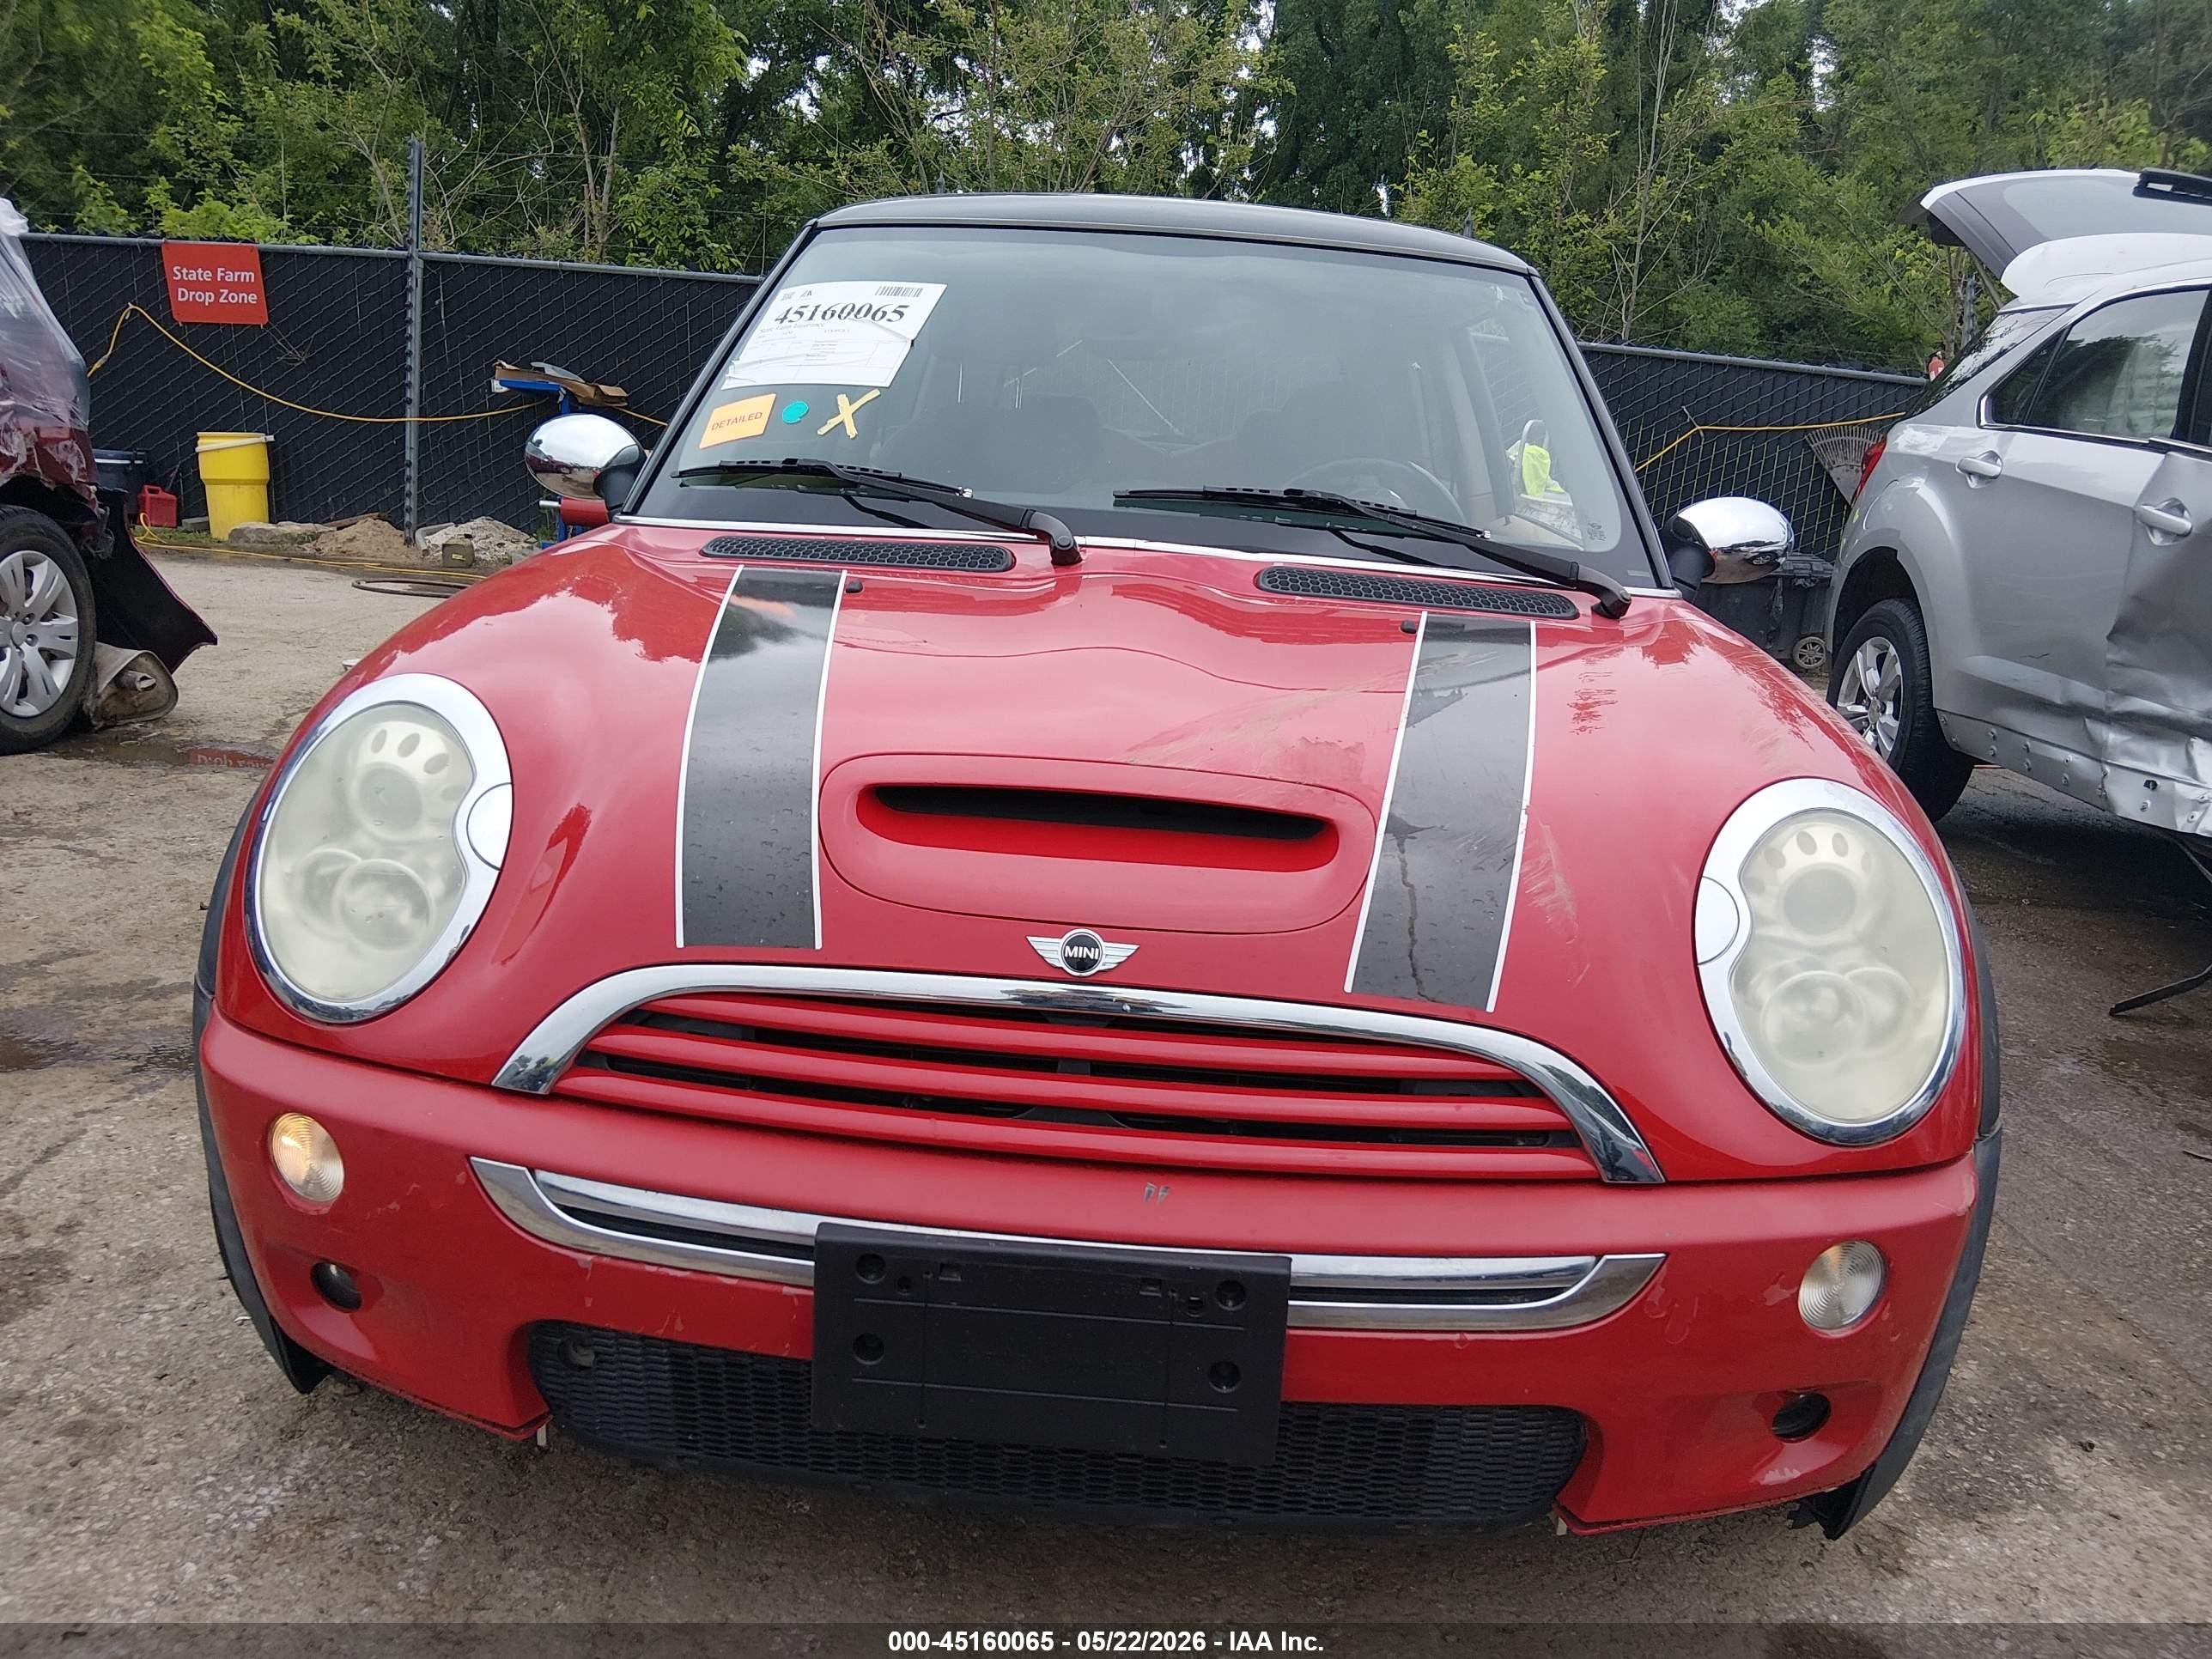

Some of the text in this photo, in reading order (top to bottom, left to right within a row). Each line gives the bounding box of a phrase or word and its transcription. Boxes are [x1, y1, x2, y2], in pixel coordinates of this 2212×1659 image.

[173, 266, 255, 283] State Farm
[178, 288, 258, 307] Drop Zone
[775, 302, 910, 324] 45160065
[711, 411, 763, 431] DETAILED
[1064, 945, 1099, 960] MINI
